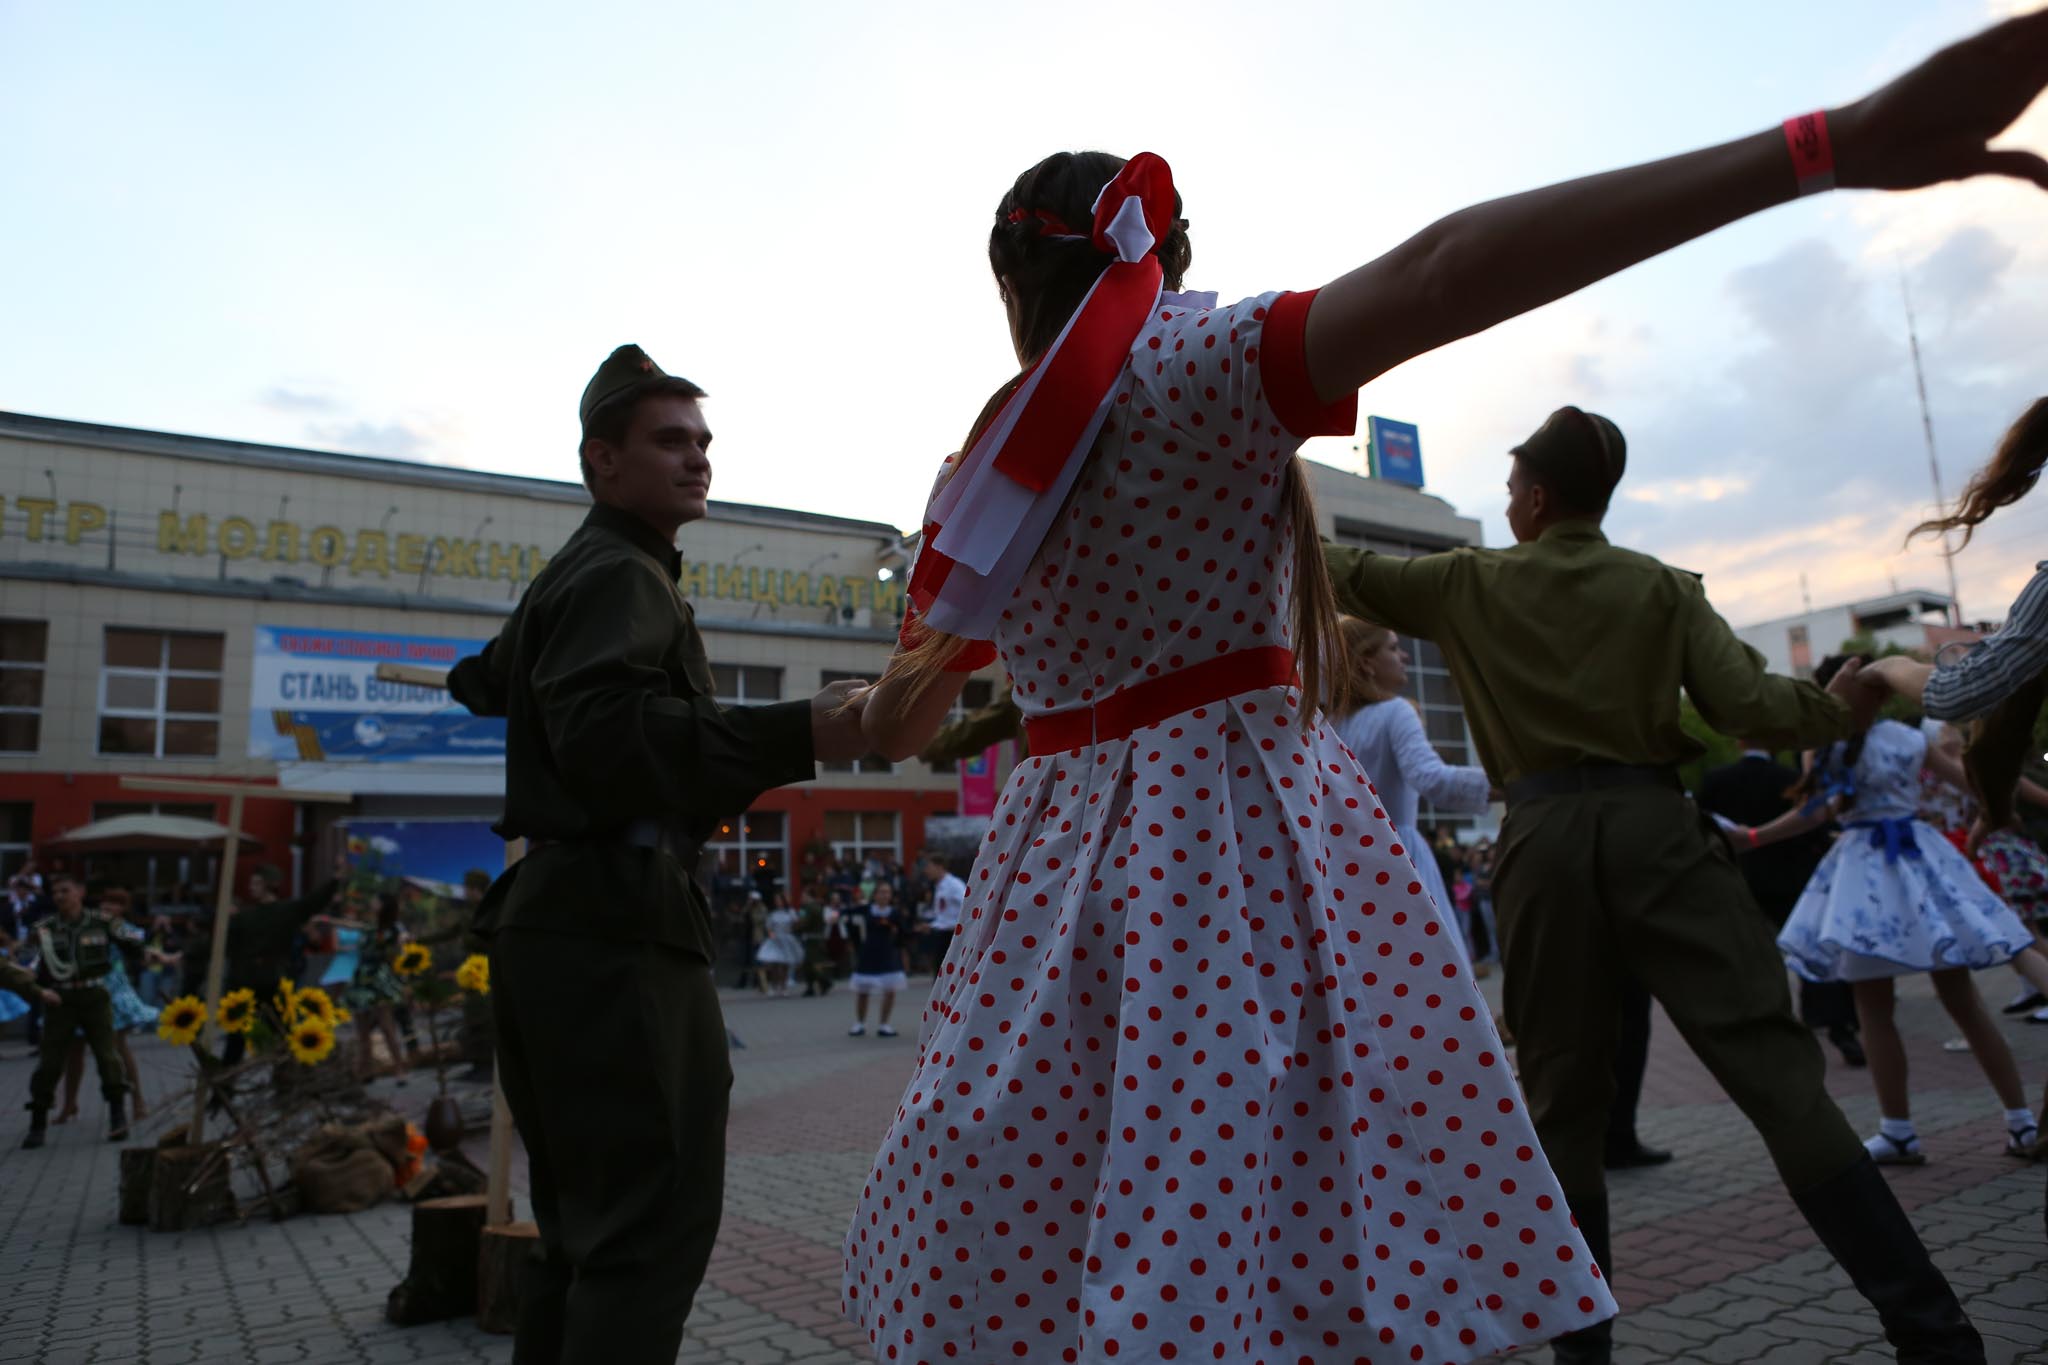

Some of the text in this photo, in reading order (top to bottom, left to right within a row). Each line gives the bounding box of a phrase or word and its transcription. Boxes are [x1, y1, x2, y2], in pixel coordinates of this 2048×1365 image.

[0, 496, 107, 545] ТР
[680, 560, 906, 614] НИЦИАТИ
[280, 671, 359, 701] СТАНЬ
